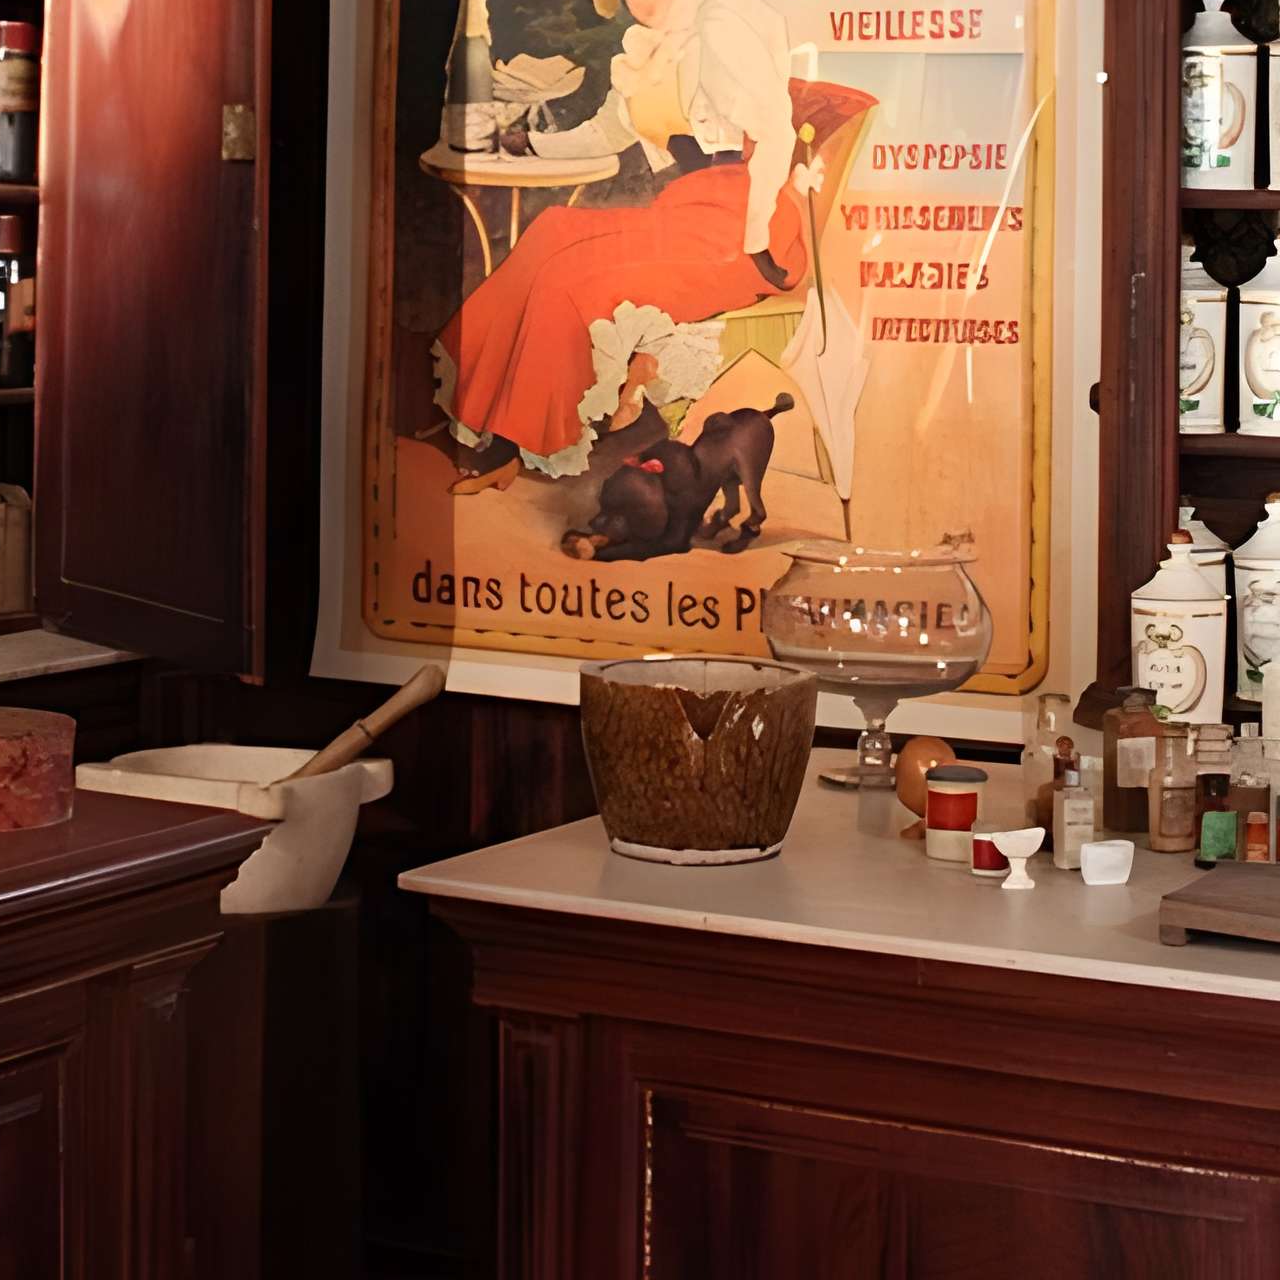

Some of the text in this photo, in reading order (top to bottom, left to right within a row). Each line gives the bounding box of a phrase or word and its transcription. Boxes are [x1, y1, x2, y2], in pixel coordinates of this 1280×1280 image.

[830, 8, 983, 41] VIEILLESSE
[412, 560, 503, 610] dans
[520, 572, 650, 623] toutes
[667, 581, 720, 630] les
